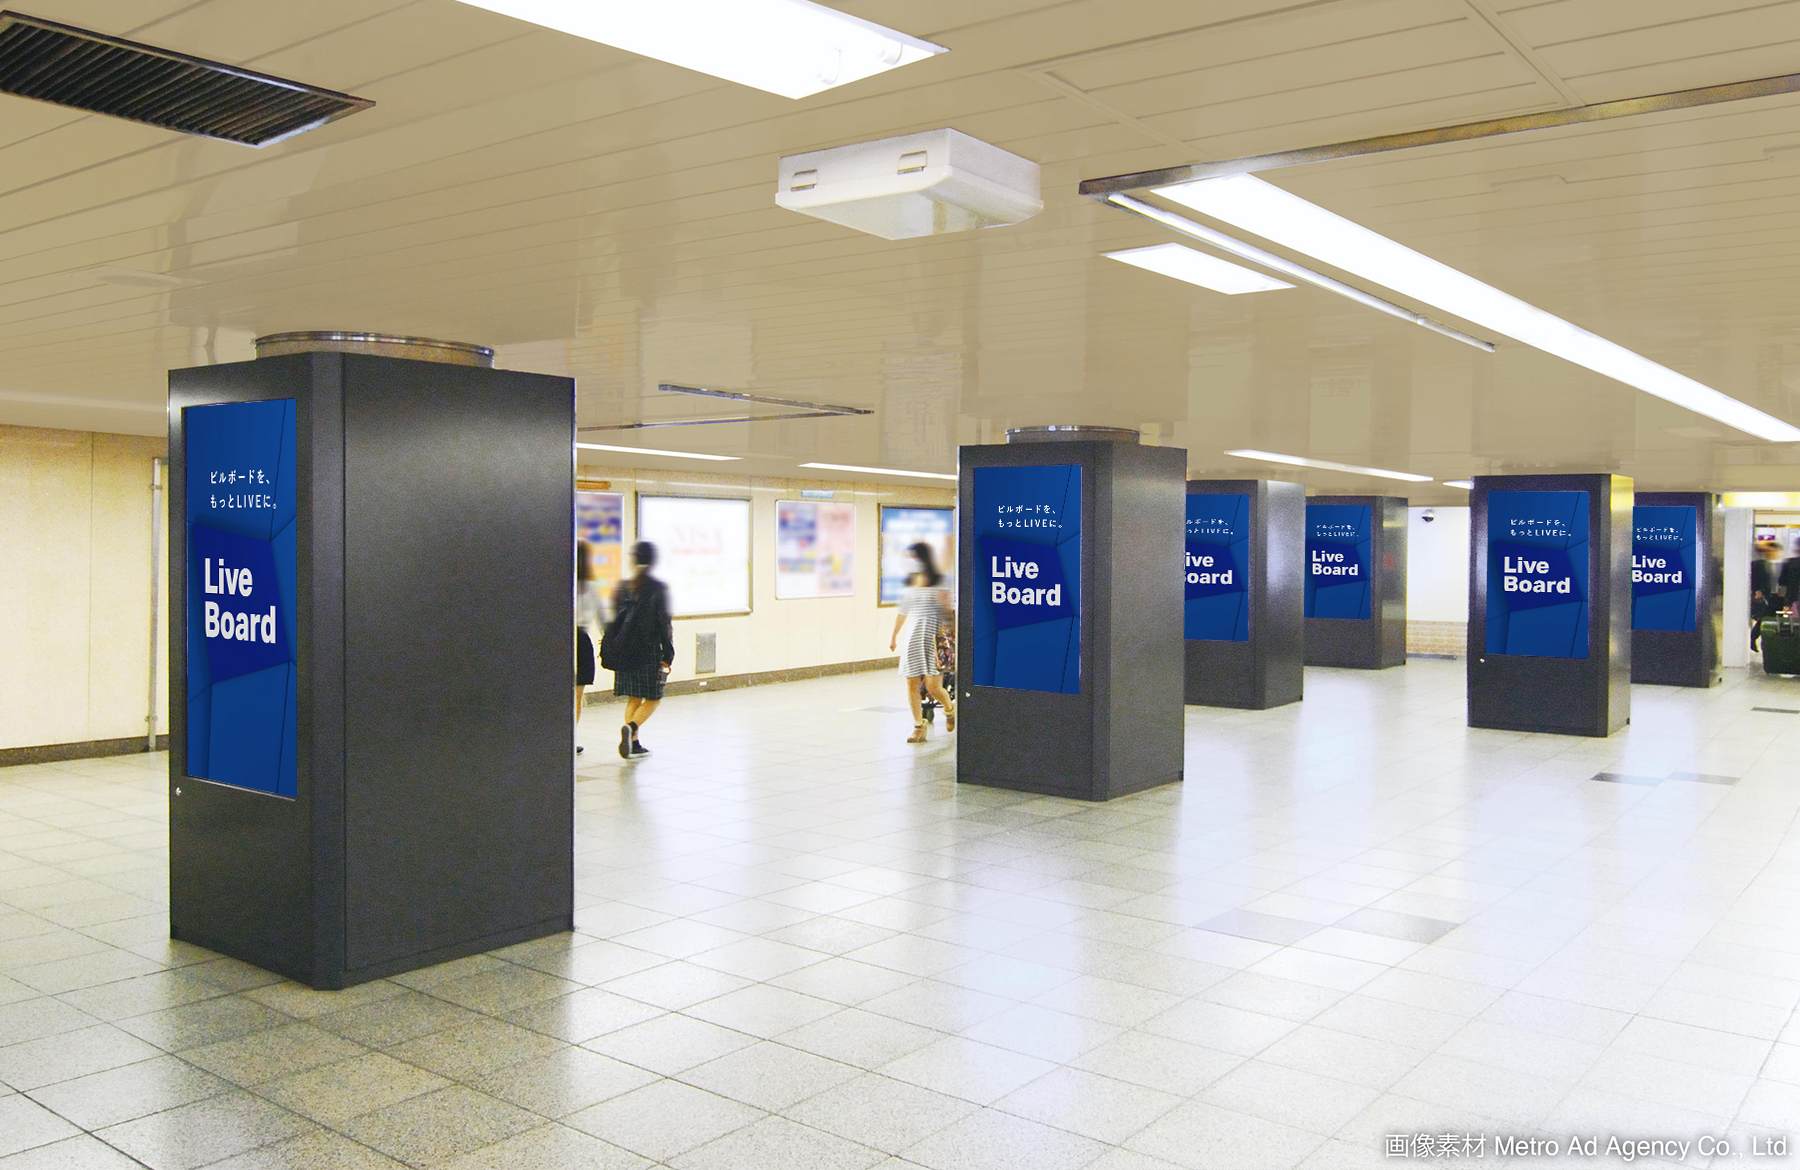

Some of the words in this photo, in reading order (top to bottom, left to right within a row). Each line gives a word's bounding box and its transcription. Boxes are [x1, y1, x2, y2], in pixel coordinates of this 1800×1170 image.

[210, 468, 270, 485] ビルボードを、
[210, 493, 277, 510] もっとLIVEに。
[998, 504, 1056, 515] ビルボードを、
[998, 518, 1063, 529] もっとLIVEに。
[1510, 519, 1566, 527] ビルボードを、
[1510, 528, 1572, 537] もっとLIVEに。
[1185, 552, 1214, 568] ive
[1312, 550, 1345, 563] Live
[1632, 554, 1667, 569] Live
[991, 556, 1040, 580] Live
[1312, 563, 1359, 576] Board
[1503, 556, 1550, 574] Live
[204, 557, 253, 597] Live
[1185, 570, 1233, 585] oard
[1632, 569, 1682, 584] Board
[1503, 575, 1571, 595] Board
[991, 582, 1061, 607] Board
[204, 601, 277, 644] Board
